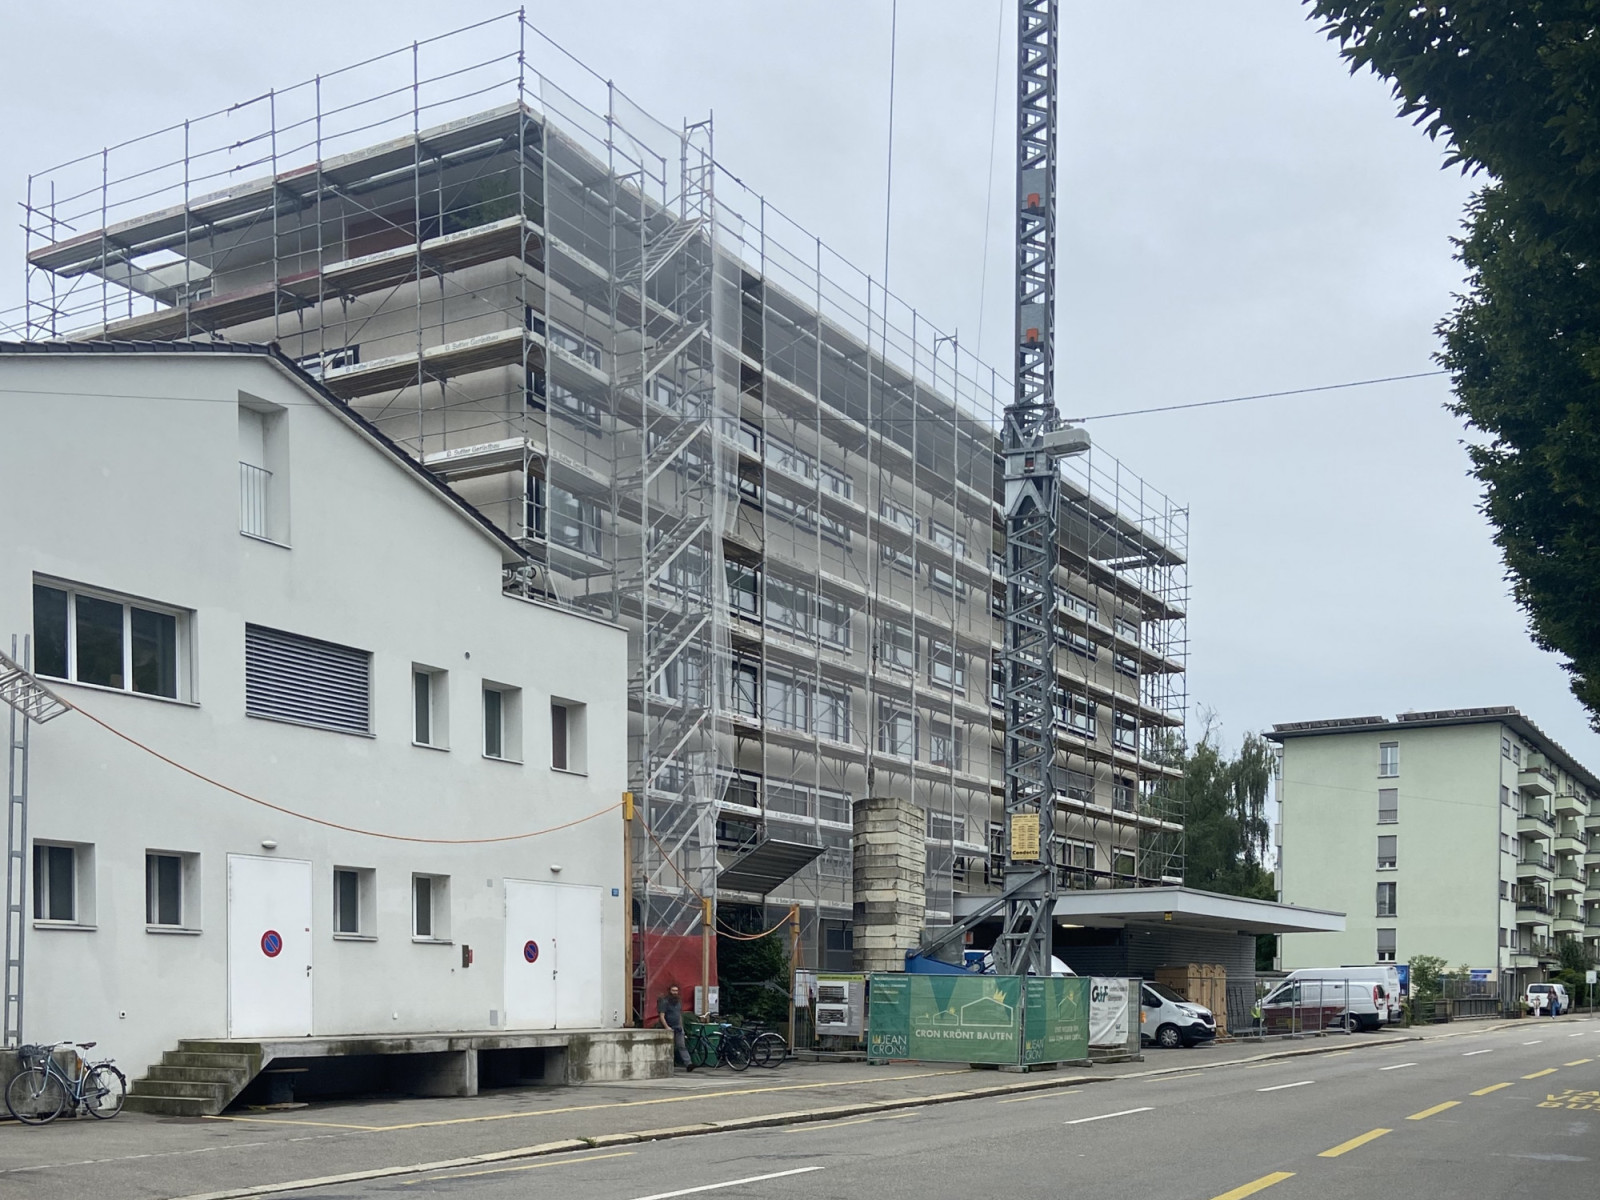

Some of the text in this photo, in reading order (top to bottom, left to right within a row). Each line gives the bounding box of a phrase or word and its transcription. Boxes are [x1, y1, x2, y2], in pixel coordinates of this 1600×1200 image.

[880, 1034, 907, 1045] JEAN
[915, 1028, 1013, 1041] CRON KRÖNT BAUTEN
[871, 1044, 902, 1055] CRON
